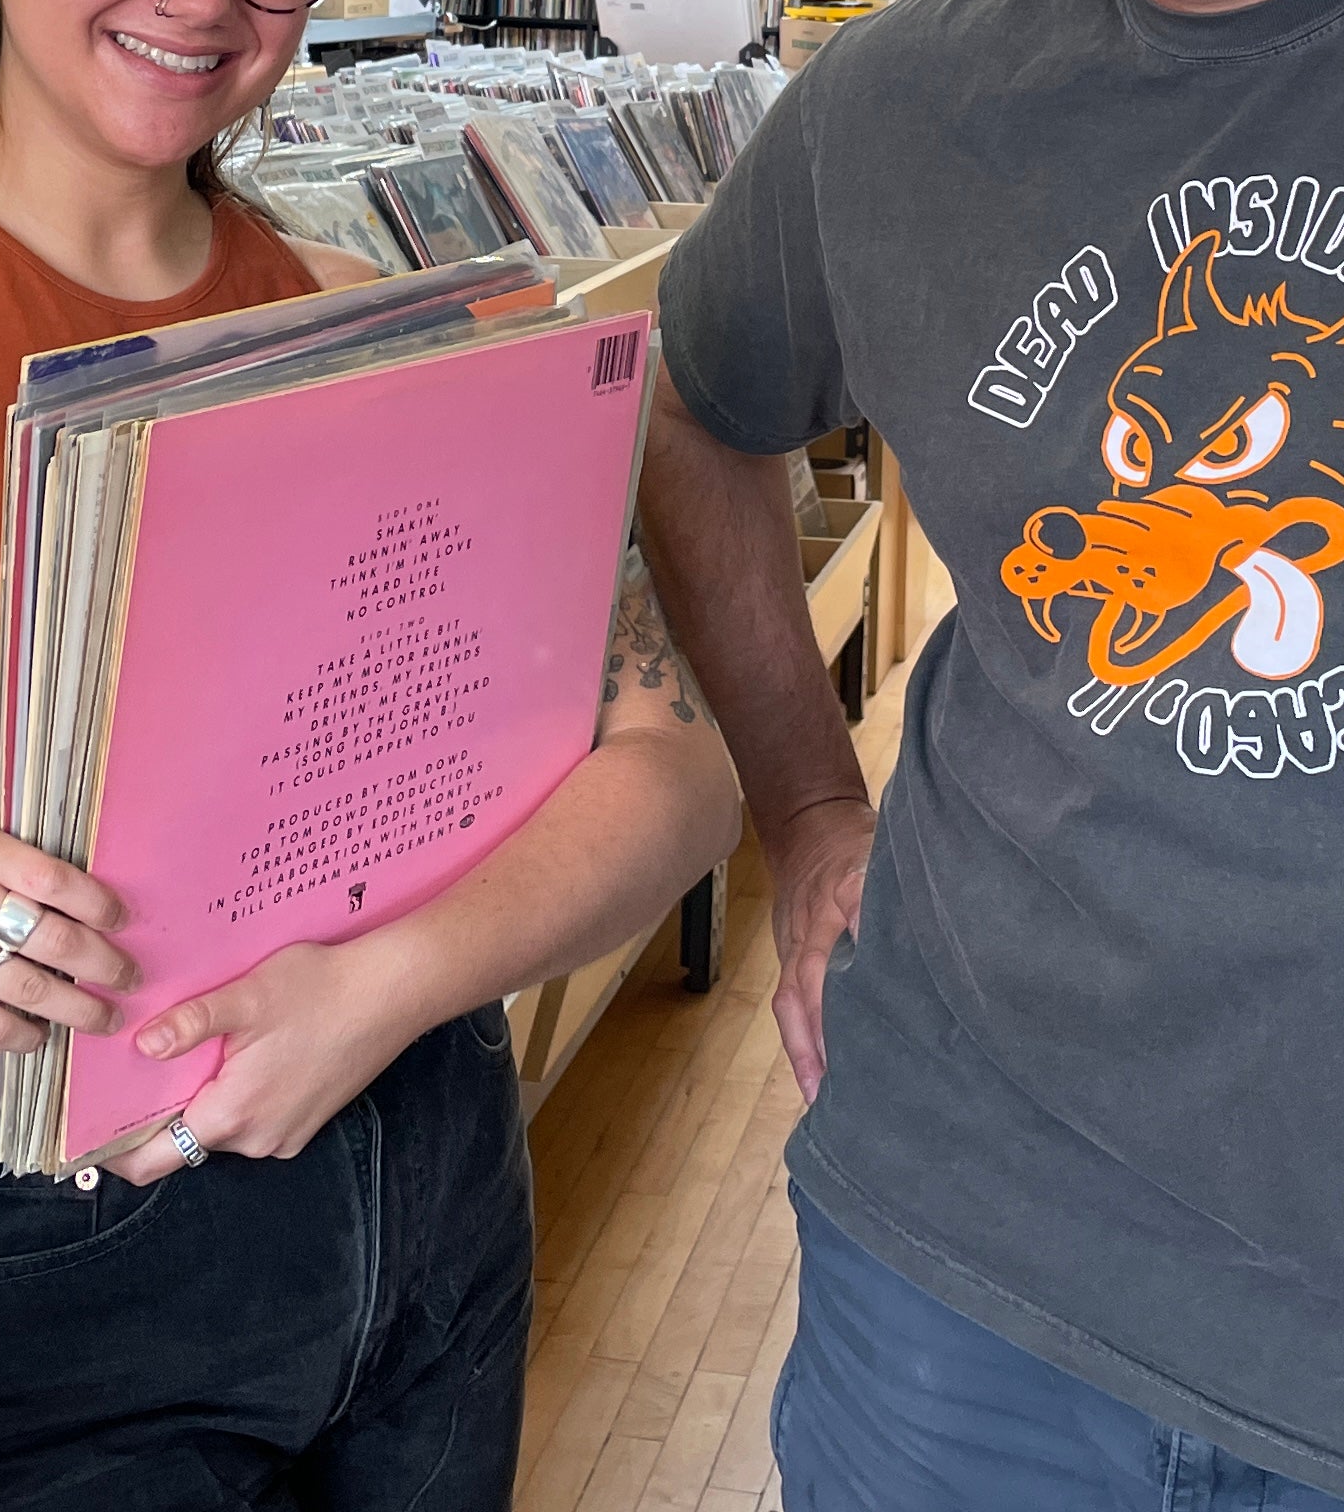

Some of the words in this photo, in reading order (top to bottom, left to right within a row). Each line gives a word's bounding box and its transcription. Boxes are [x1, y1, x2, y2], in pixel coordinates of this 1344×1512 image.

[968, 244, 1119, 428] DEAD
[330, 566, 378, 592] THINK
[385, 558, 406, 574] I'M
[413, 551, 429, 566] IN
[436, 537, 472, 560] LOVE
[348, 538, 413, 568] RUNNIN'
[419, 523, 461, 546] AWAY
[376, 513, 439, 541] SHAKIN'
[346, 605, 368, 622] NO
[375, 581, 446, 613] CONTROL
[360, 577, 401, 600] HARD
[409, 565, 440, 585] LIFE
[283, 706, 305, 724] MY
[392, 670, 412, 686] MY
[419, 645, 482, 676] FRIENDS
[285, 682, 324, 705] KEEP
[332, 671, 353, 689] MY
[360, 650, 415, 679] MOTOR
[422, 627, 483, 658] RUNNIN'
[317, 653, 356, 676] TAKE
[362, 648, 372, 661] A
[379, 629, 430, 656] LITTLE
[437, 618, 461, 636] BIT
[261, 731, 333, 768] PASSING
[342, 721, 360, 739] BY
[367, 710, 394, 729] THE
[402, 676, 491, 717] GRAVEYARD
[295, 741, 345, 770] (SONG
[353, 728, 383, 749] FOR
[390, 711, 431, 735] JOHN
[310, 700, 371, 733] DRIVIN'
[379, 691, 398, 707] ME
[405, 672, 454, 698] CRAZY
[267, 792, 354, 835] PRODUCED
[361, 783, 379, 799] BY
[386, 769, 418, 790] TOM
[425, 748, 469, 776] DOWD
[269, 781, 285, 797] IT
[292, 759, 346, 788] COULD
[353, 734, 413, 765] HAPPEN
[422, 724, 439, 740] TO
[447, 711, 476, 731] YOU
[208, 897, 225, 914] IN
[233, 838, 373, 903] COLLABORATION
[380, 820, 418, 844] WITH
[425, 805, 455, 827] TOM
[462, 785, 504, 811] DOWD
[241, 841, 271, 864] FOR
[279, 826, 313, 848] TOM
[320, 804, 369, 833] DOWD
[376, 760, 484, 811] PRODUCTIONS
[251, 833, 338, 877] ARRANGED
[346, 823, 364, 840] BY
[371, 803, 416, 830] EDDIE
[423, 781, 473, 809] MONEY
[230, 899, 265, 923] BILL
[273, 868, 342, 905] GRAHAM
[348, 821, 455, 875] MANAGEMENT
